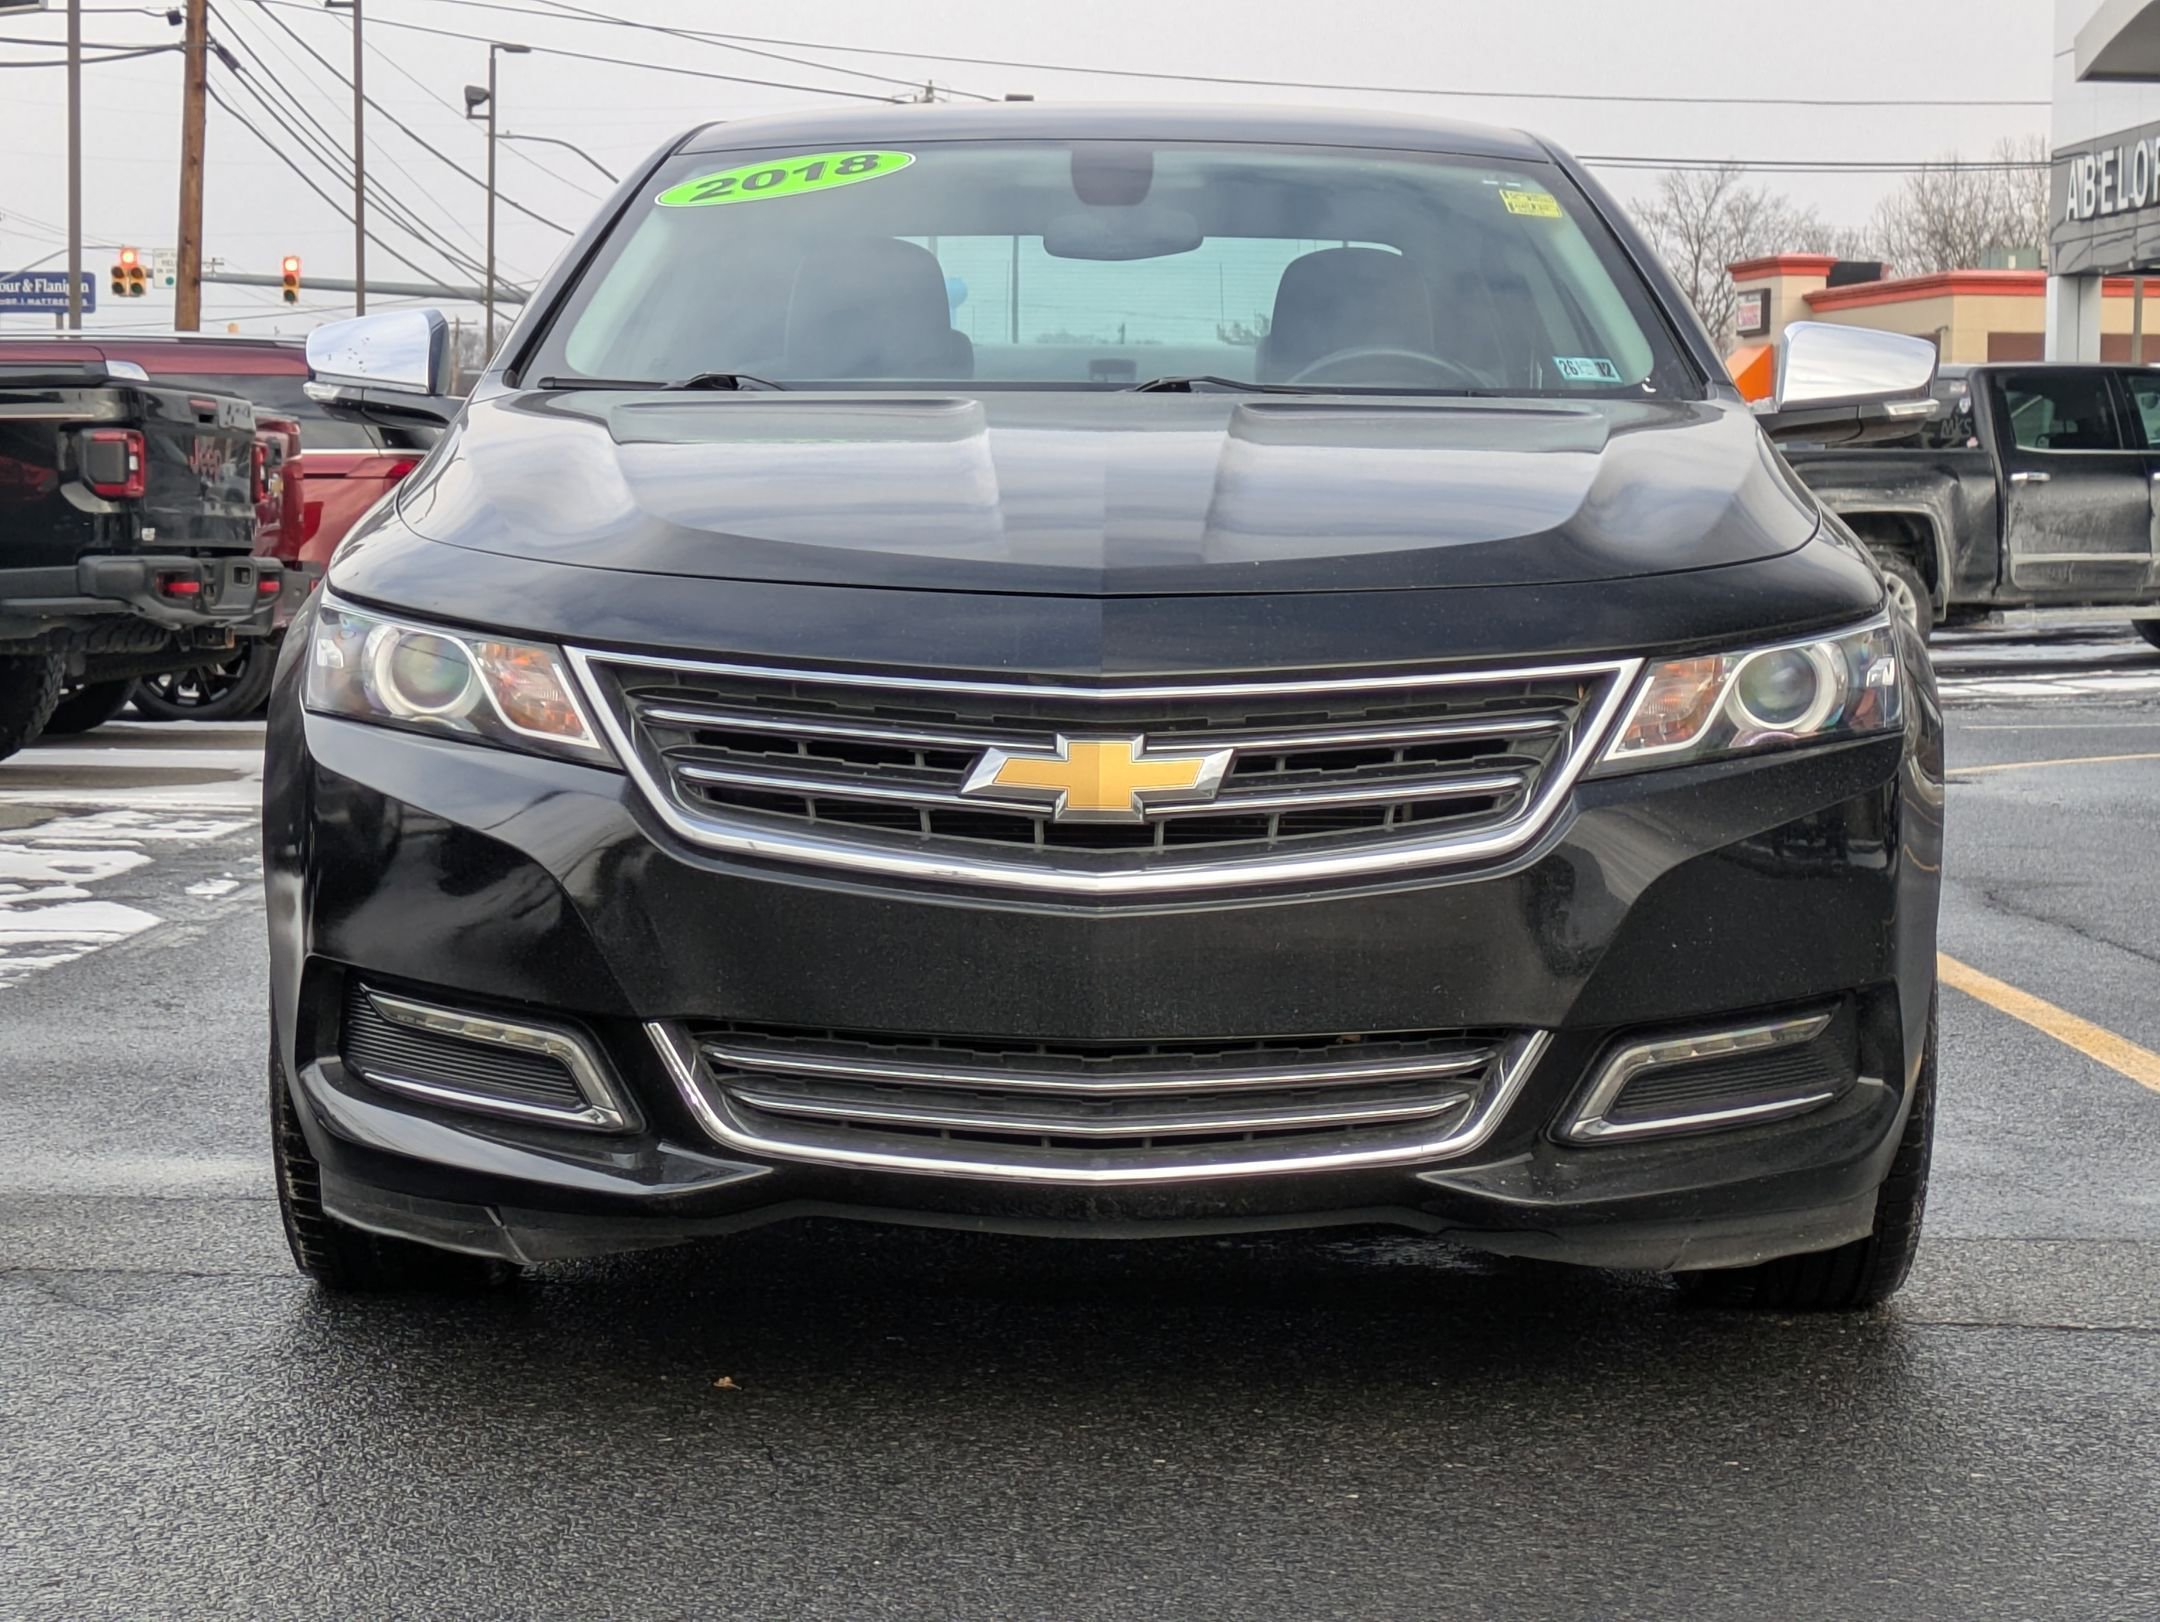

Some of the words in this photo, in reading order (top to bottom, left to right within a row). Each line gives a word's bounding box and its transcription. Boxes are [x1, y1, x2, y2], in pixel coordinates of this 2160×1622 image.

[690, 154, 880, 203] 2018
[22, 278, 34, 293] &
[35, 278, 90, 297] Flanin
